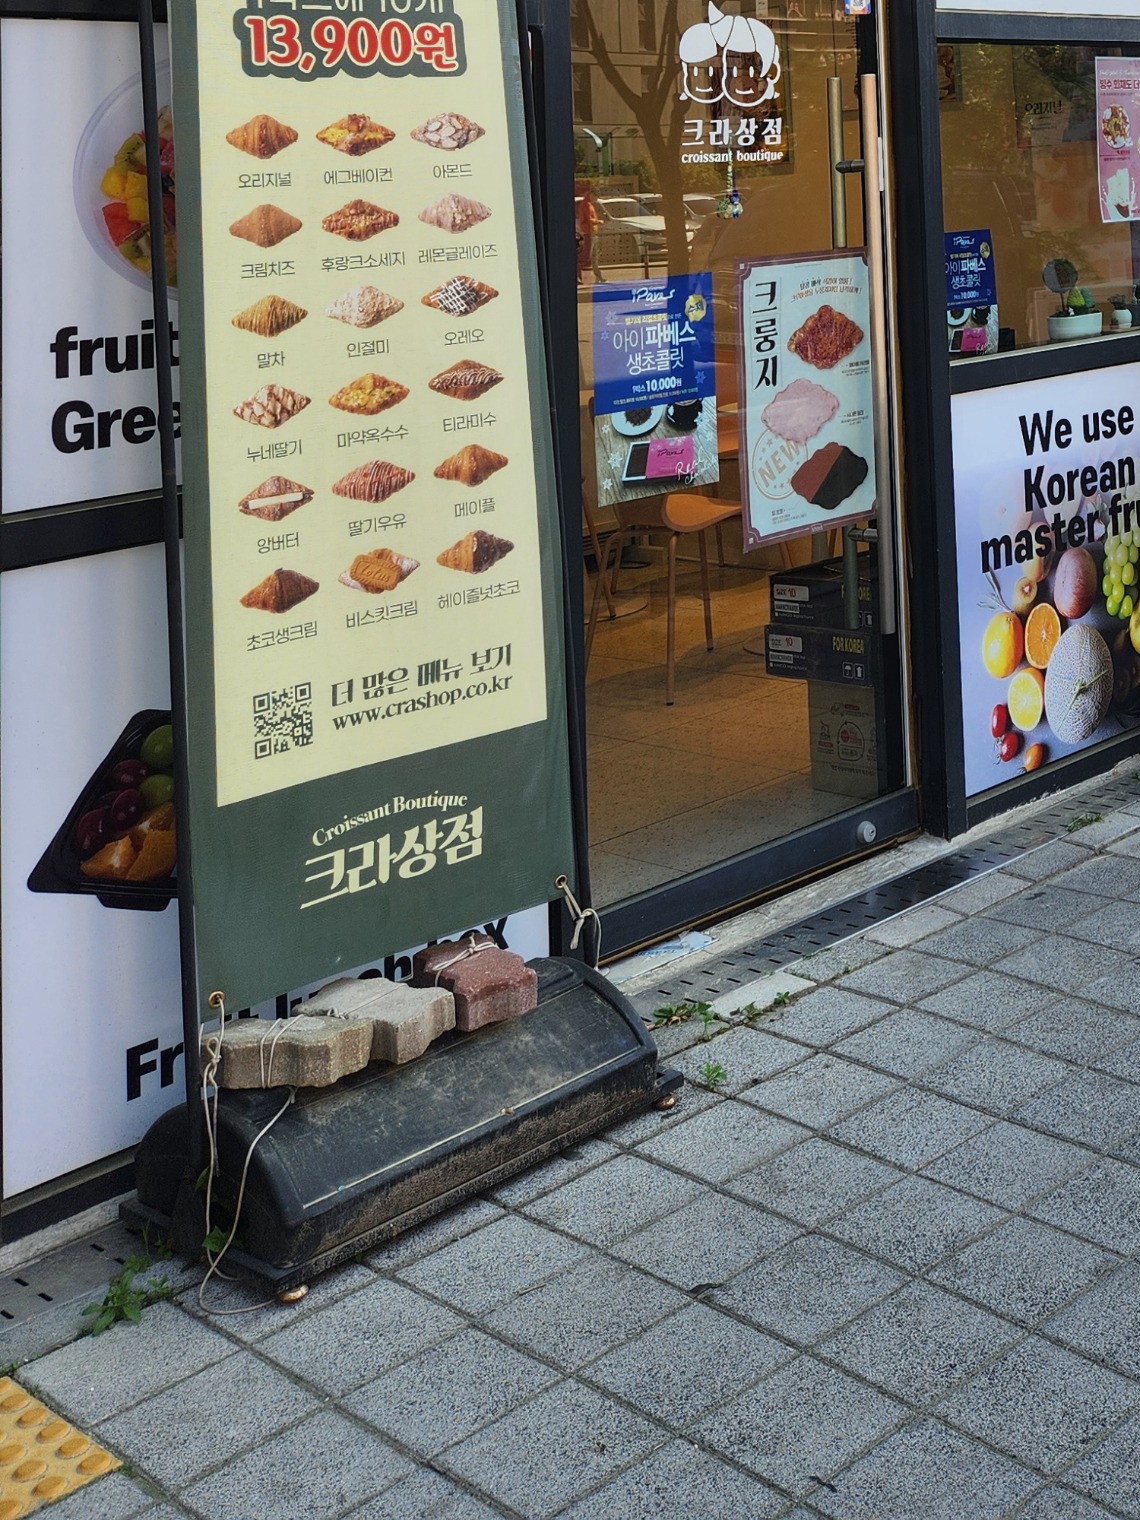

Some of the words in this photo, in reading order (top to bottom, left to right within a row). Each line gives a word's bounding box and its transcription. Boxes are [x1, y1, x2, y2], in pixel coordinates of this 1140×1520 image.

[243, 15, 460, 74] 13,900원
[682, 116, 784, 147] 크라상점
[681, 150, 733, 164] croissant
[736, 148, 784, 163] boutique
[238, 171, 292, 190] 오리지널
[323, 168, 393, 186] 에그베이컨
[432, 163, 473, 179] 아몬드
[321, 251, 406, 271] 후랑크소세지
[418, 243, 498, 264] 레몬글레이즈
[240, 260, 296, 278] 크림치즈
[346, 339, 390, 358] 인절미
[444, 328, 485, 348] 오레오
[752, 280, 778, 391] 크룽지
[256, 351, 285, 369] 말차
[626, 346, 684, 376] 생초콜릿
[442, 410, 498, 434] 티라미수
[1019, 409, 1072, 457] We
[1082, 404, 1135, 443] use
[337, 423, 409, 449] 마약옥수수
[246, 439, 303, 464] 누네딸기
[757, 437, 802, 488] NEW
[1023, 455, 1137, 513] Korean
[454, 496, 497, 519] 메이플
[348, 512, 407, 538] 딸기우유
[257, 531, 300, 555] 앙버터
[980, 507, 1101, 574] master
[437, 578, 521, 611] 헤이즐넛초코
[345, 599, 419, 630] 비스킷크림
[246, 620, 318, 652] 초코생크림
[832, 635, 845, 652] FOR
[845, 637, 865, 654] KOREA
[330, 680, 352, 709] 더
[361, 665, 409, 699] 많은
[417, 651, 464, 686] 메뉴
[470, 642, 513, 674] 보기
[331, 672, 514, 733] www.crashop.co.kr
[312, 802, 391, 848] Croissant
[391, 791, 468, 817] Boutique
[299, 805, 485, 911] 크라상점
